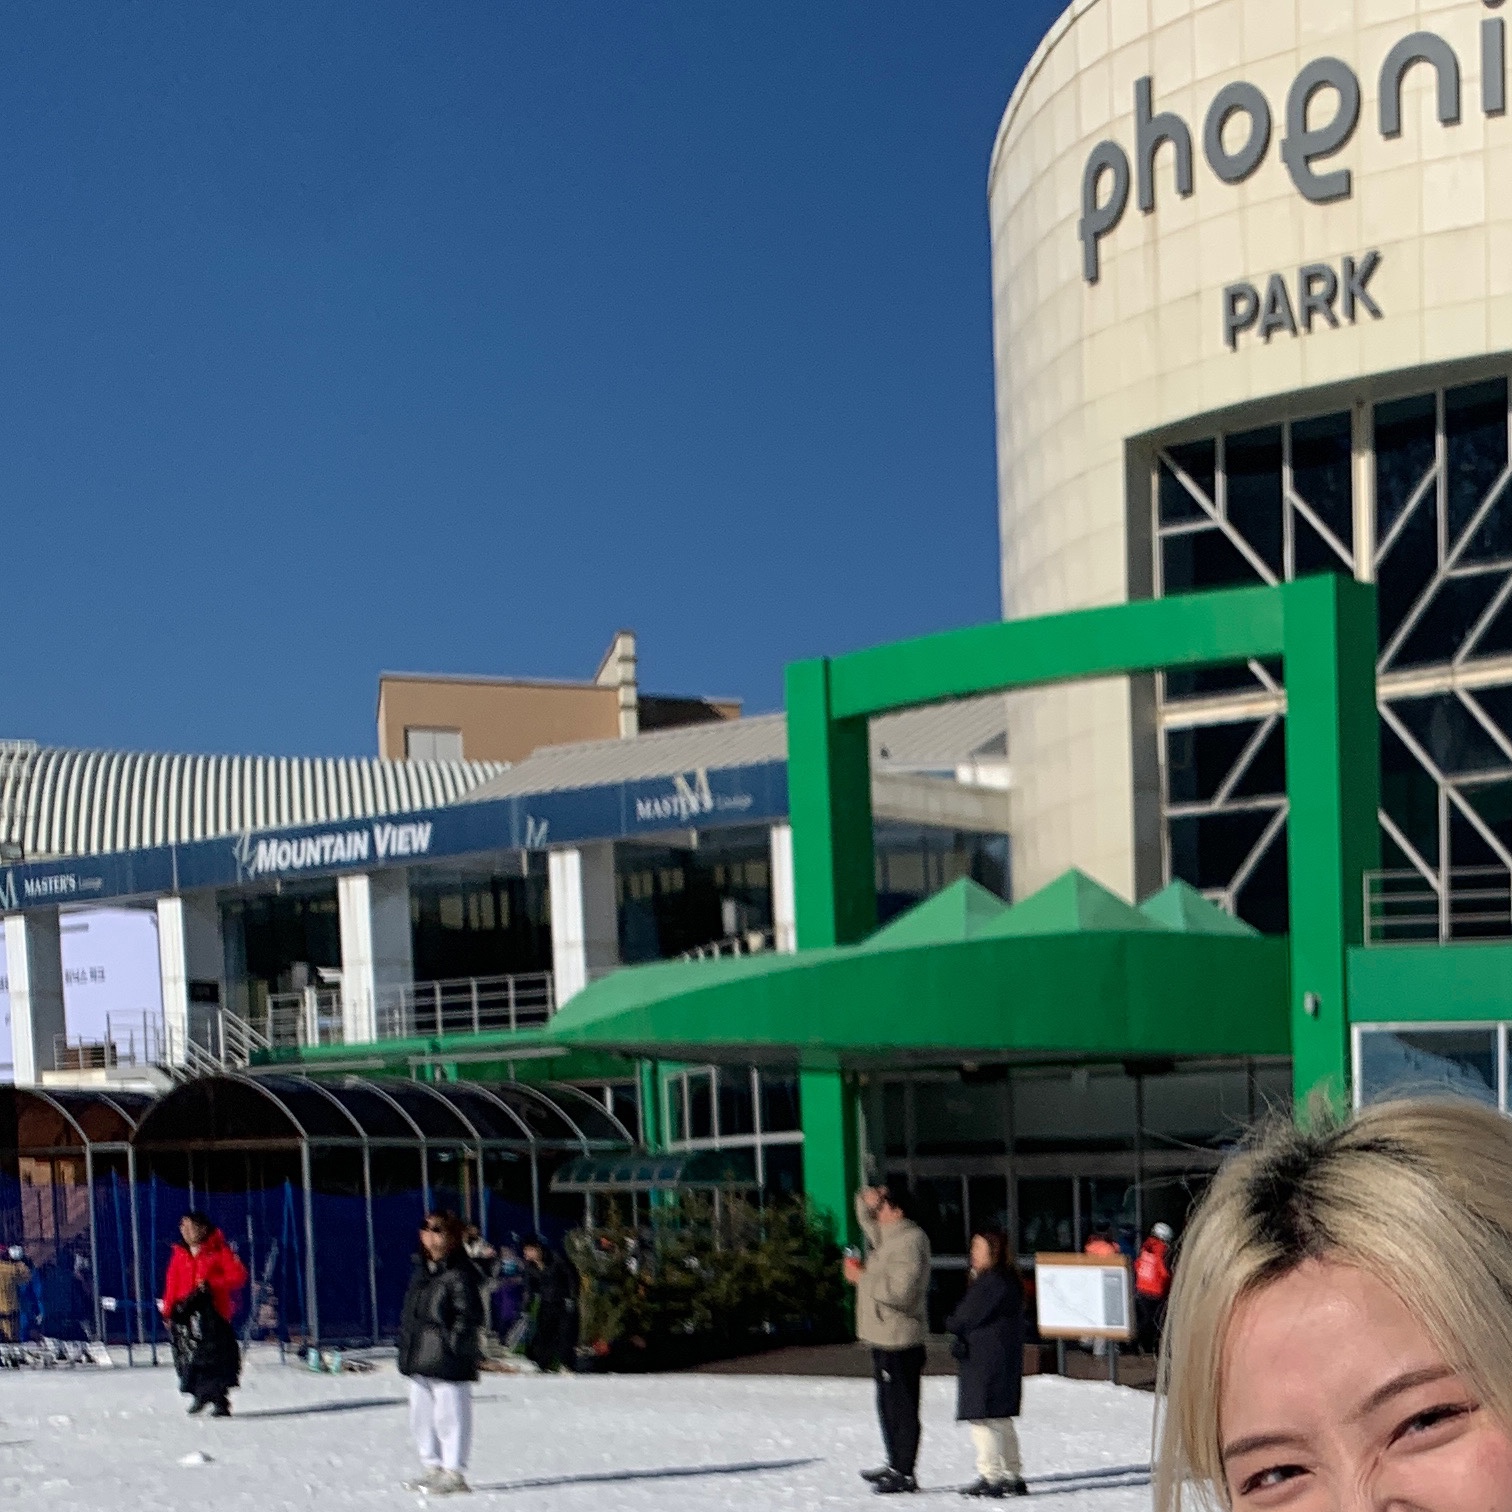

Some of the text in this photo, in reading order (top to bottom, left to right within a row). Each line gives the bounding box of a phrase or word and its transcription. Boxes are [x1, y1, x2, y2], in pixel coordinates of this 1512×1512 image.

[1222, 250, 1384, 352] PARK
[256, 821, 433, 874] MOUNTAIN VIEW
[24, 874, 76, 898] MASTER'S
